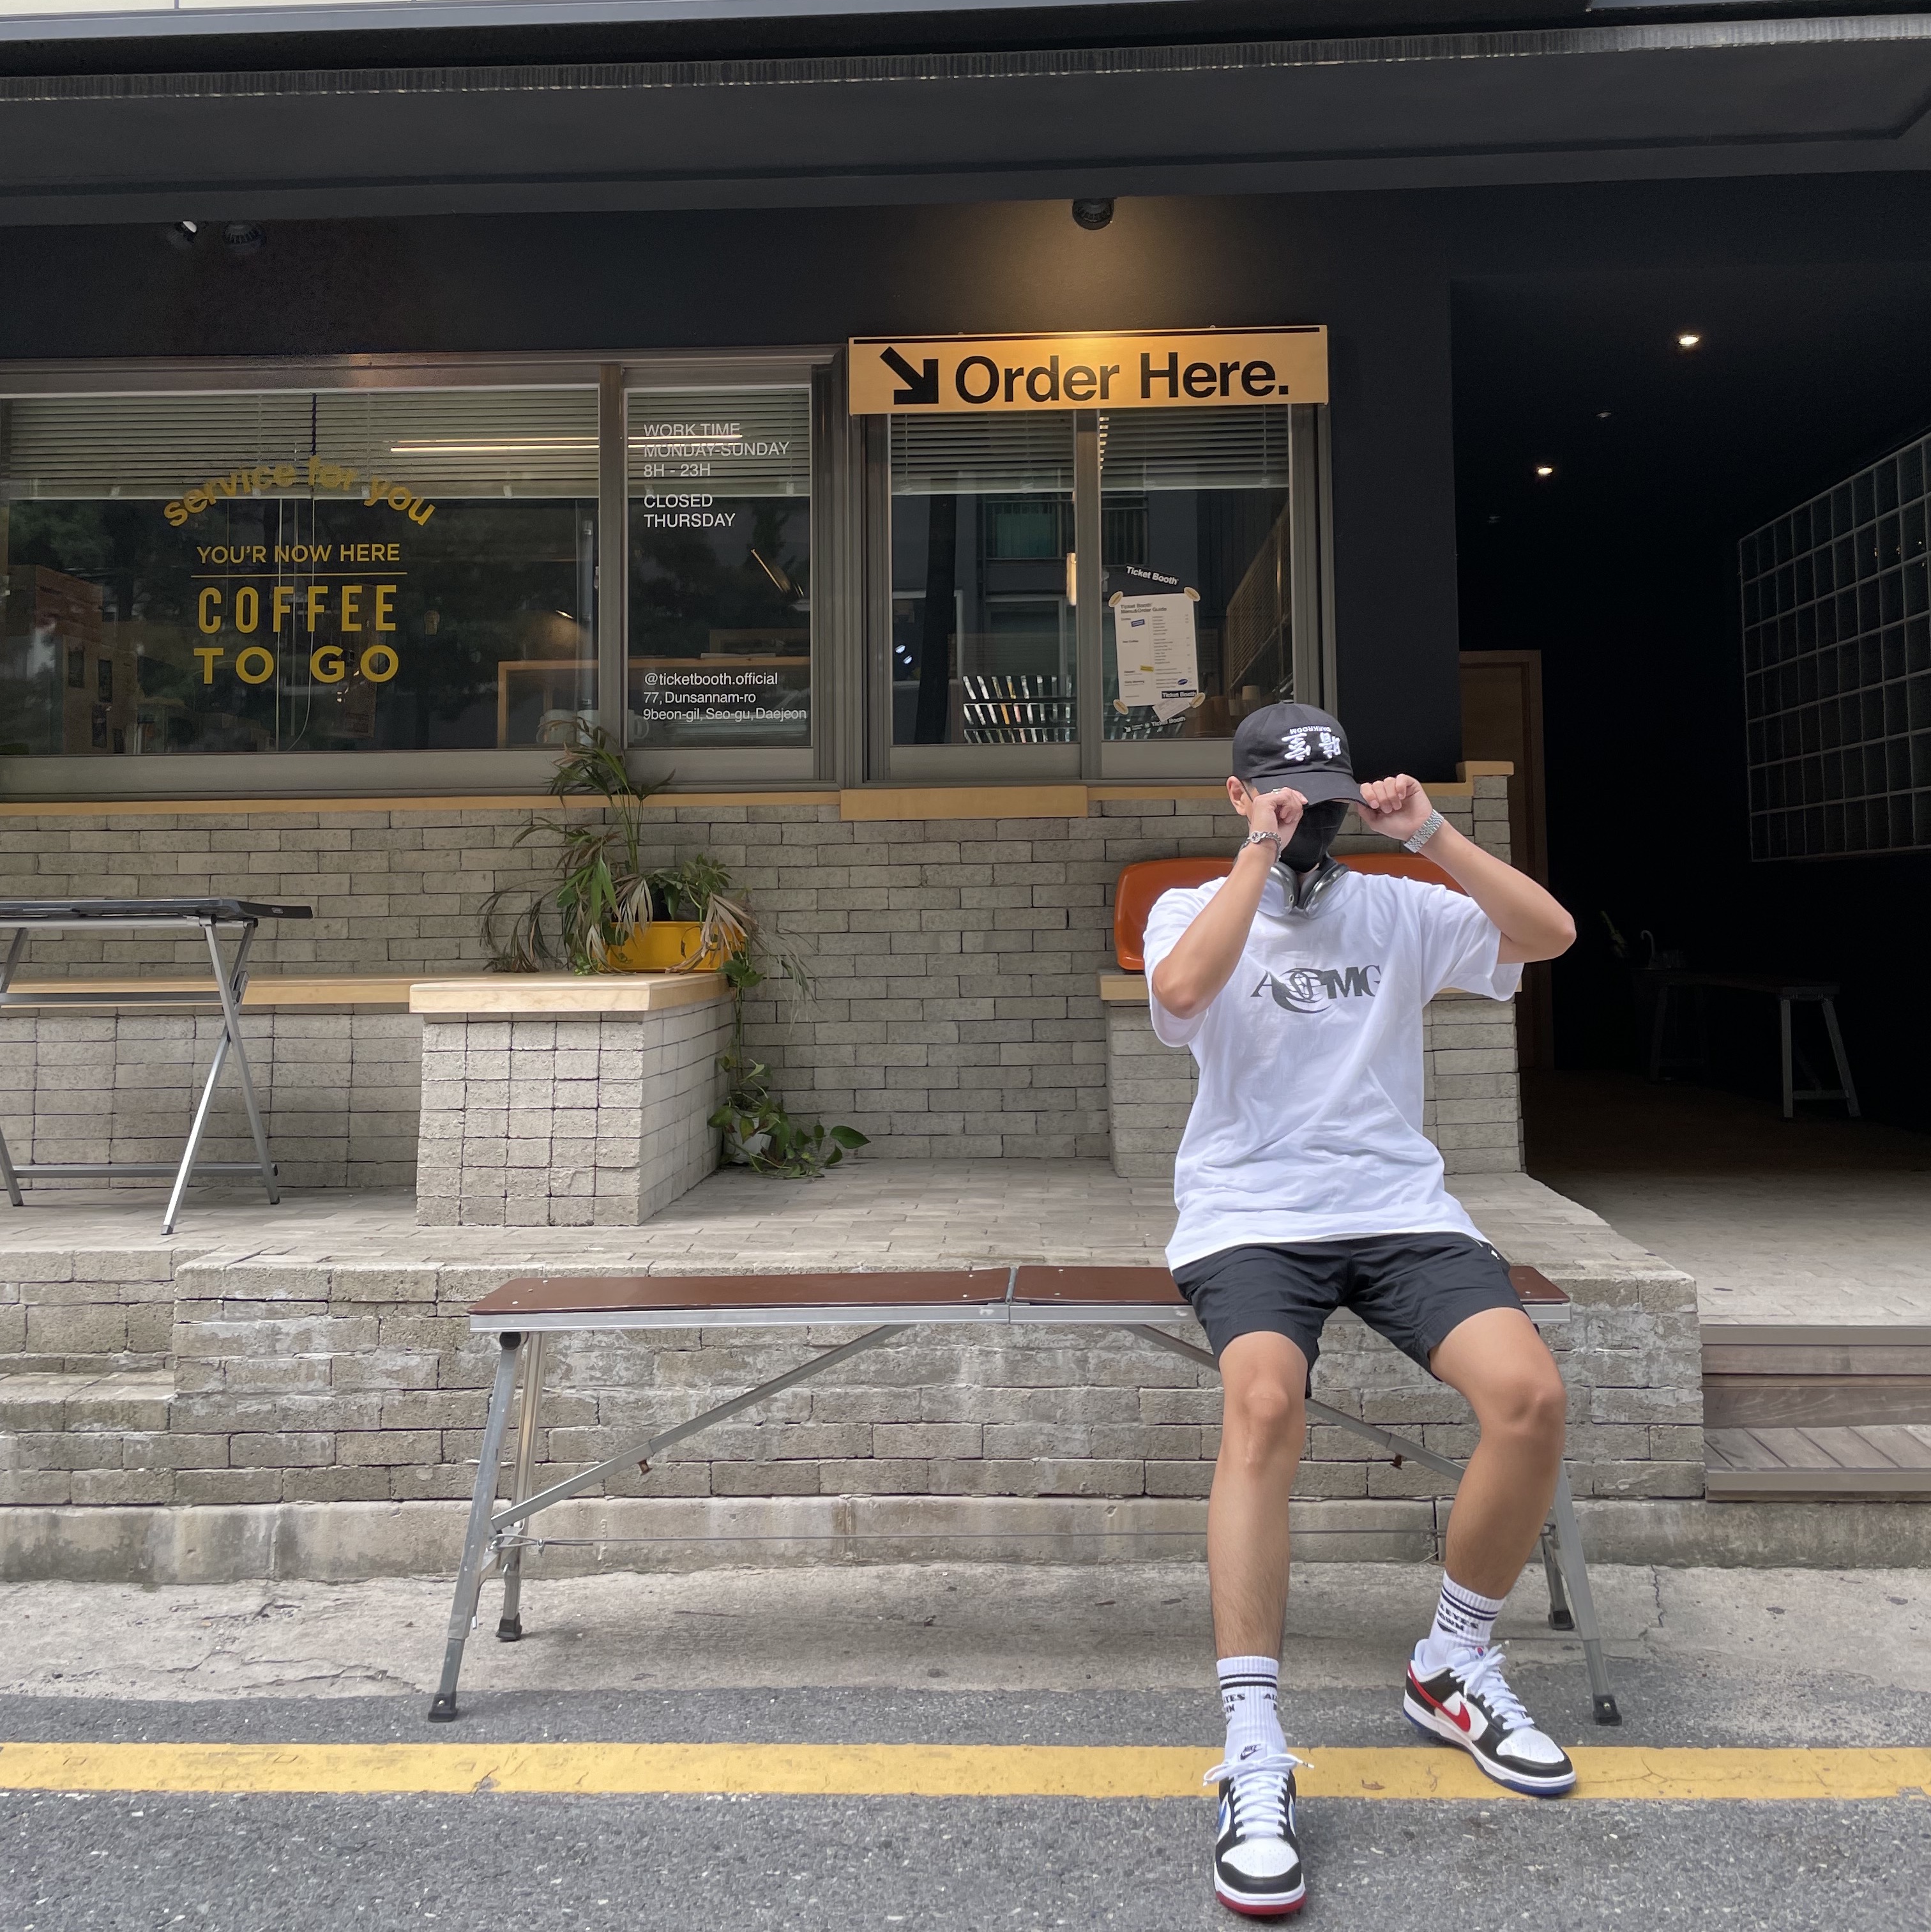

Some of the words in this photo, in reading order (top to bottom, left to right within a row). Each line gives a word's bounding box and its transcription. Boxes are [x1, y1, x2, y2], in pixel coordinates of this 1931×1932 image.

[955, 355, 1119, 404] Order
[1140, 352, 1289, 399] Here.
[643, 423, 696, 437] WORK
[700, 423, 741, 436] TIME
[643, 441, 790, 457] MONDAY-SUNDAY
[643, 464, 665, 477] 8H
[679, 463, 711, 476] 23H
[164, 462, 296, 527] service
[308, 455, 358, 491] for
[363, 478, 435, 526] you
[643, 494, 713, 508] CLOSED
[643, 513, 736, 528] THURSDAY
[196, 544, 266, 564] YOU'R
[275, 544, 333, 563] NOW
[340, 543, 400, 562] HERE
[1126, 566, 1151, 579] Ticket
[1152, 572, 1178, 585] Booth
[199, 584, 397, 634] COFFEE
[193, 646, 274, 685] TO
[310, 644, 399, 683] GO
[644, 673, 778, 686] @ticketbooth.official
[643, 692, 662, 705] 77,
[665, 691, 756, 703] Dunsannam-ro
[643, 708, 703, 722] 9beon-gil,
[706, 708, 753, 722] Seo-gu,
[756, 707, 806, 722] Daejeon
